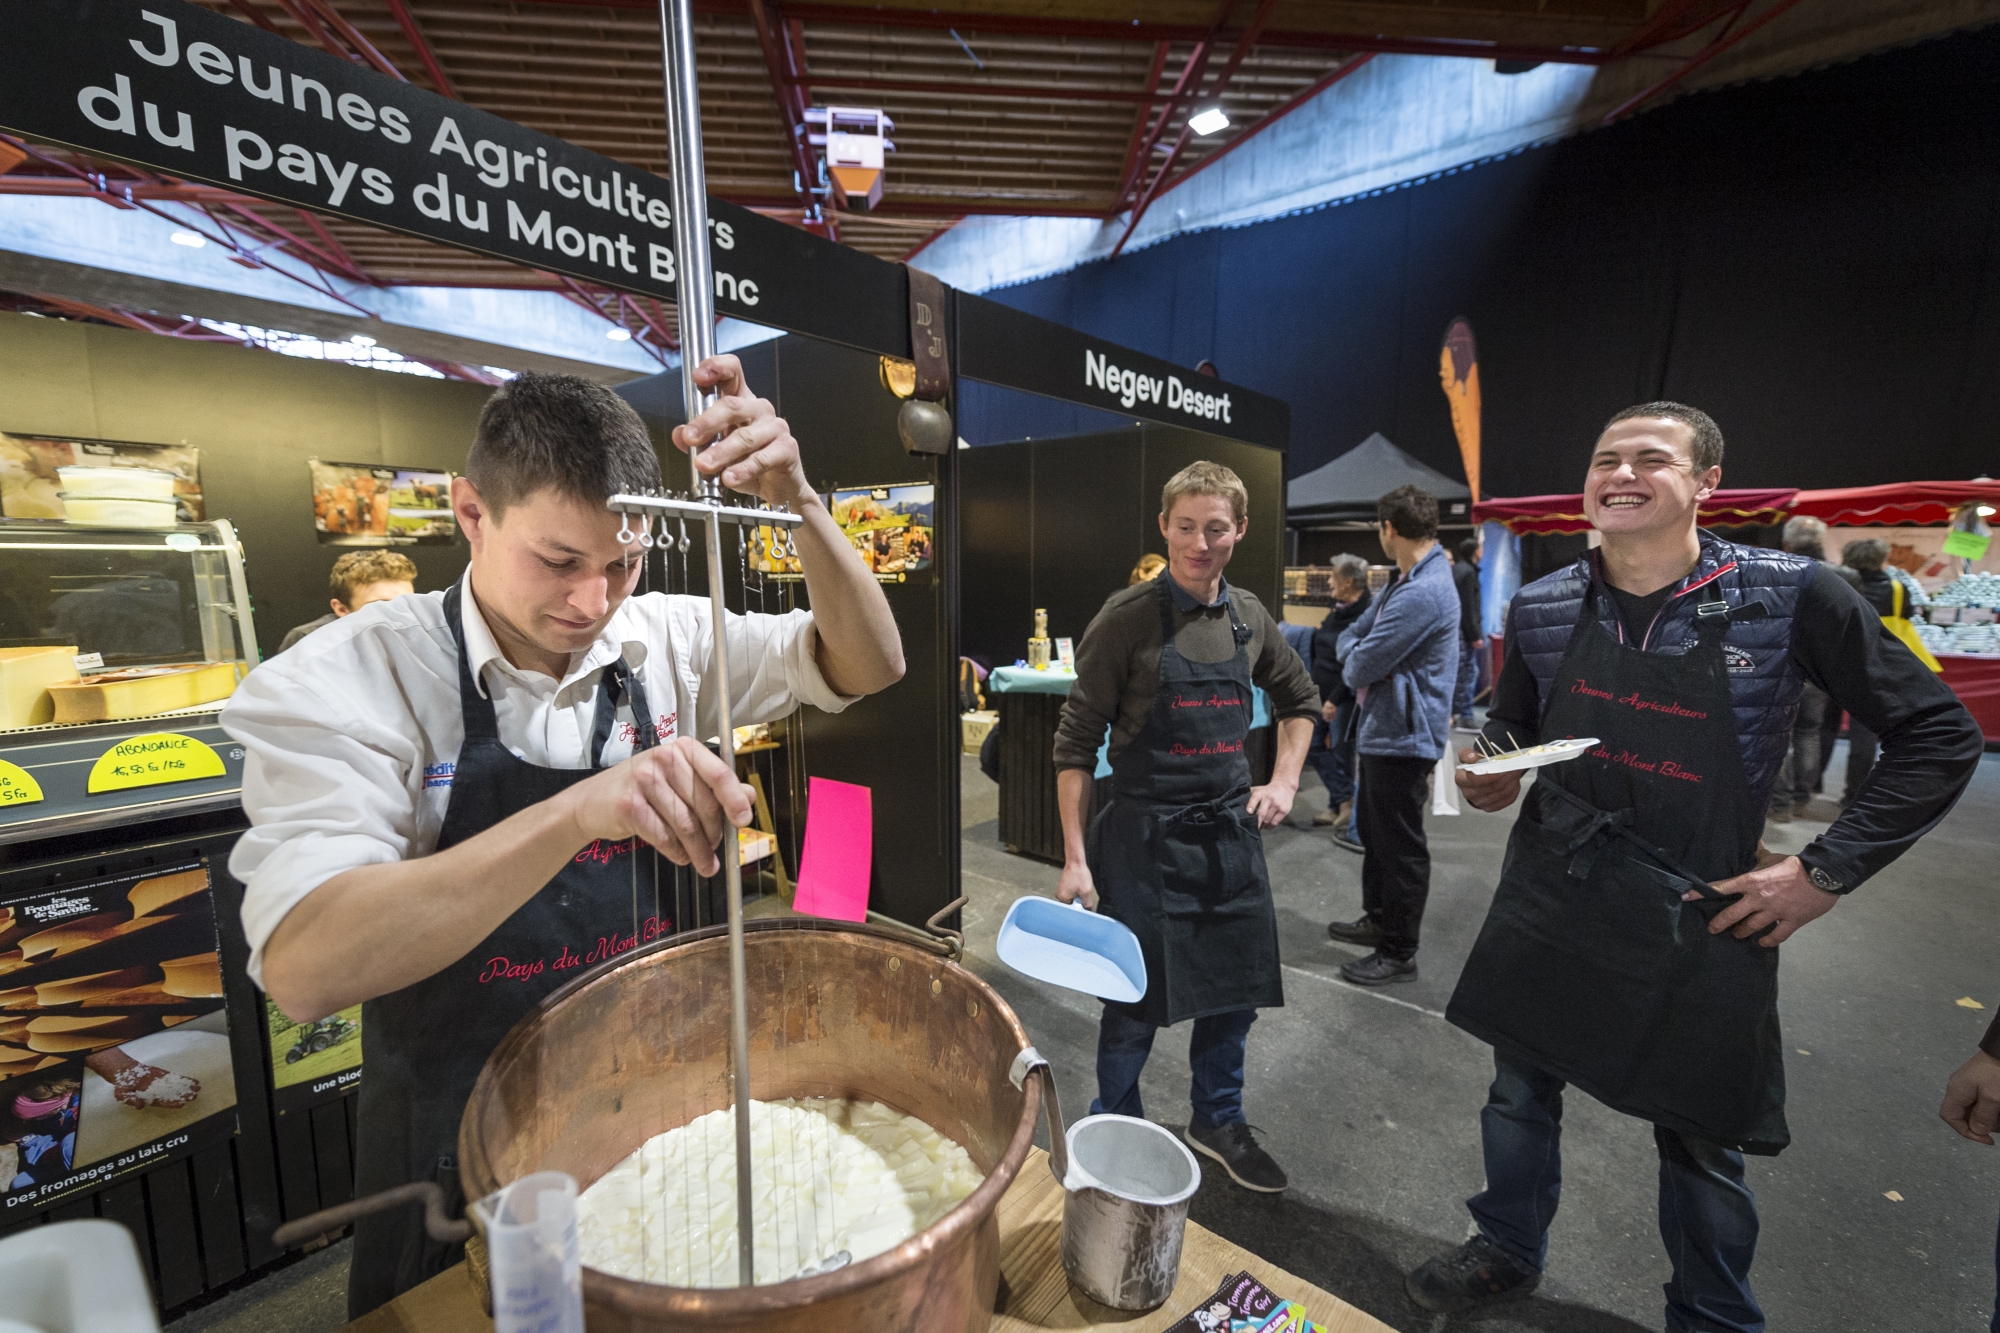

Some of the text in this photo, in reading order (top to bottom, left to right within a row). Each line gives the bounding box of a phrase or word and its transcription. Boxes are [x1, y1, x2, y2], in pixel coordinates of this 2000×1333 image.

[128, 9, 736, 250] Jeunes Agricultes
[77, 73, 760, 306] du pays du Mont Bnc
[1085, 349, 1232, 424] Negev Desert
[1171, 694, 1203, 710] Jeunes
[1571, 678, 1708, 719] Jeunes Agriculteurs
[115, 738, 192, 757] ABONDANCE
[1169, 742, 1198, 757] Pays
[1198, 743, 1212, 755] du
[1592, 744, 1611, 759] du
[1613, 750, 1657, 773] Mont
[1658, 760, 1704, 783] Blanc
[24, 896, 90, 916] Fromages
[34, 910, 48, 919] de
[47, 903, 92, 918] Savoie
[51, 896, 67, 904] les
[478, 955, 545, 984] Pays
[551, 944, 580, 972] du
[585, 930, 640, 964] Mont
[313, 1079, 337, 1093] Une
[6, 1134, 189, 1208] Des fromages au lait cru
[1227, 1278, 1252, 1308] Tomme
[1239, 1284, 1262, 1315] Tomme
[1254, 1294, 1272, 1311] Girl
